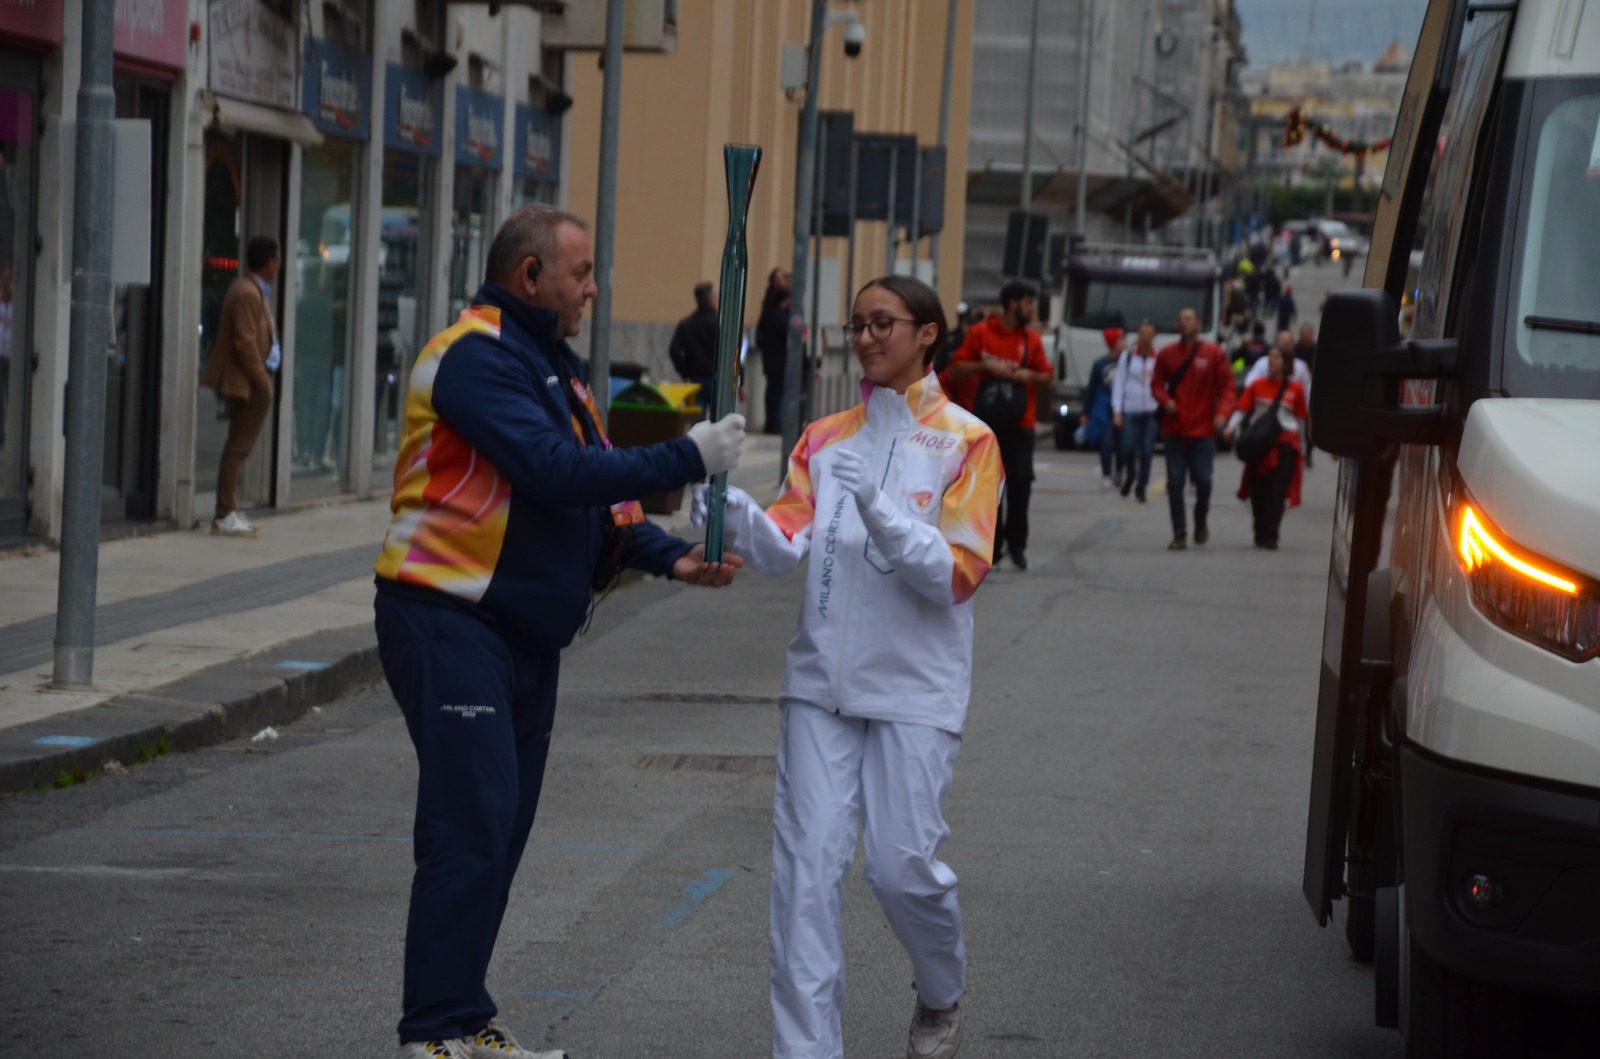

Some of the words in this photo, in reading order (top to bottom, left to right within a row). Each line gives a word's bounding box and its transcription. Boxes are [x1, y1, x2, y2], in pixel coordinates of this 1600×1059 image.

[909, 431, 956, 449] M063
[825, 494, 848, 555] CORTINA
[818, 556, 834, 619] MILANO
